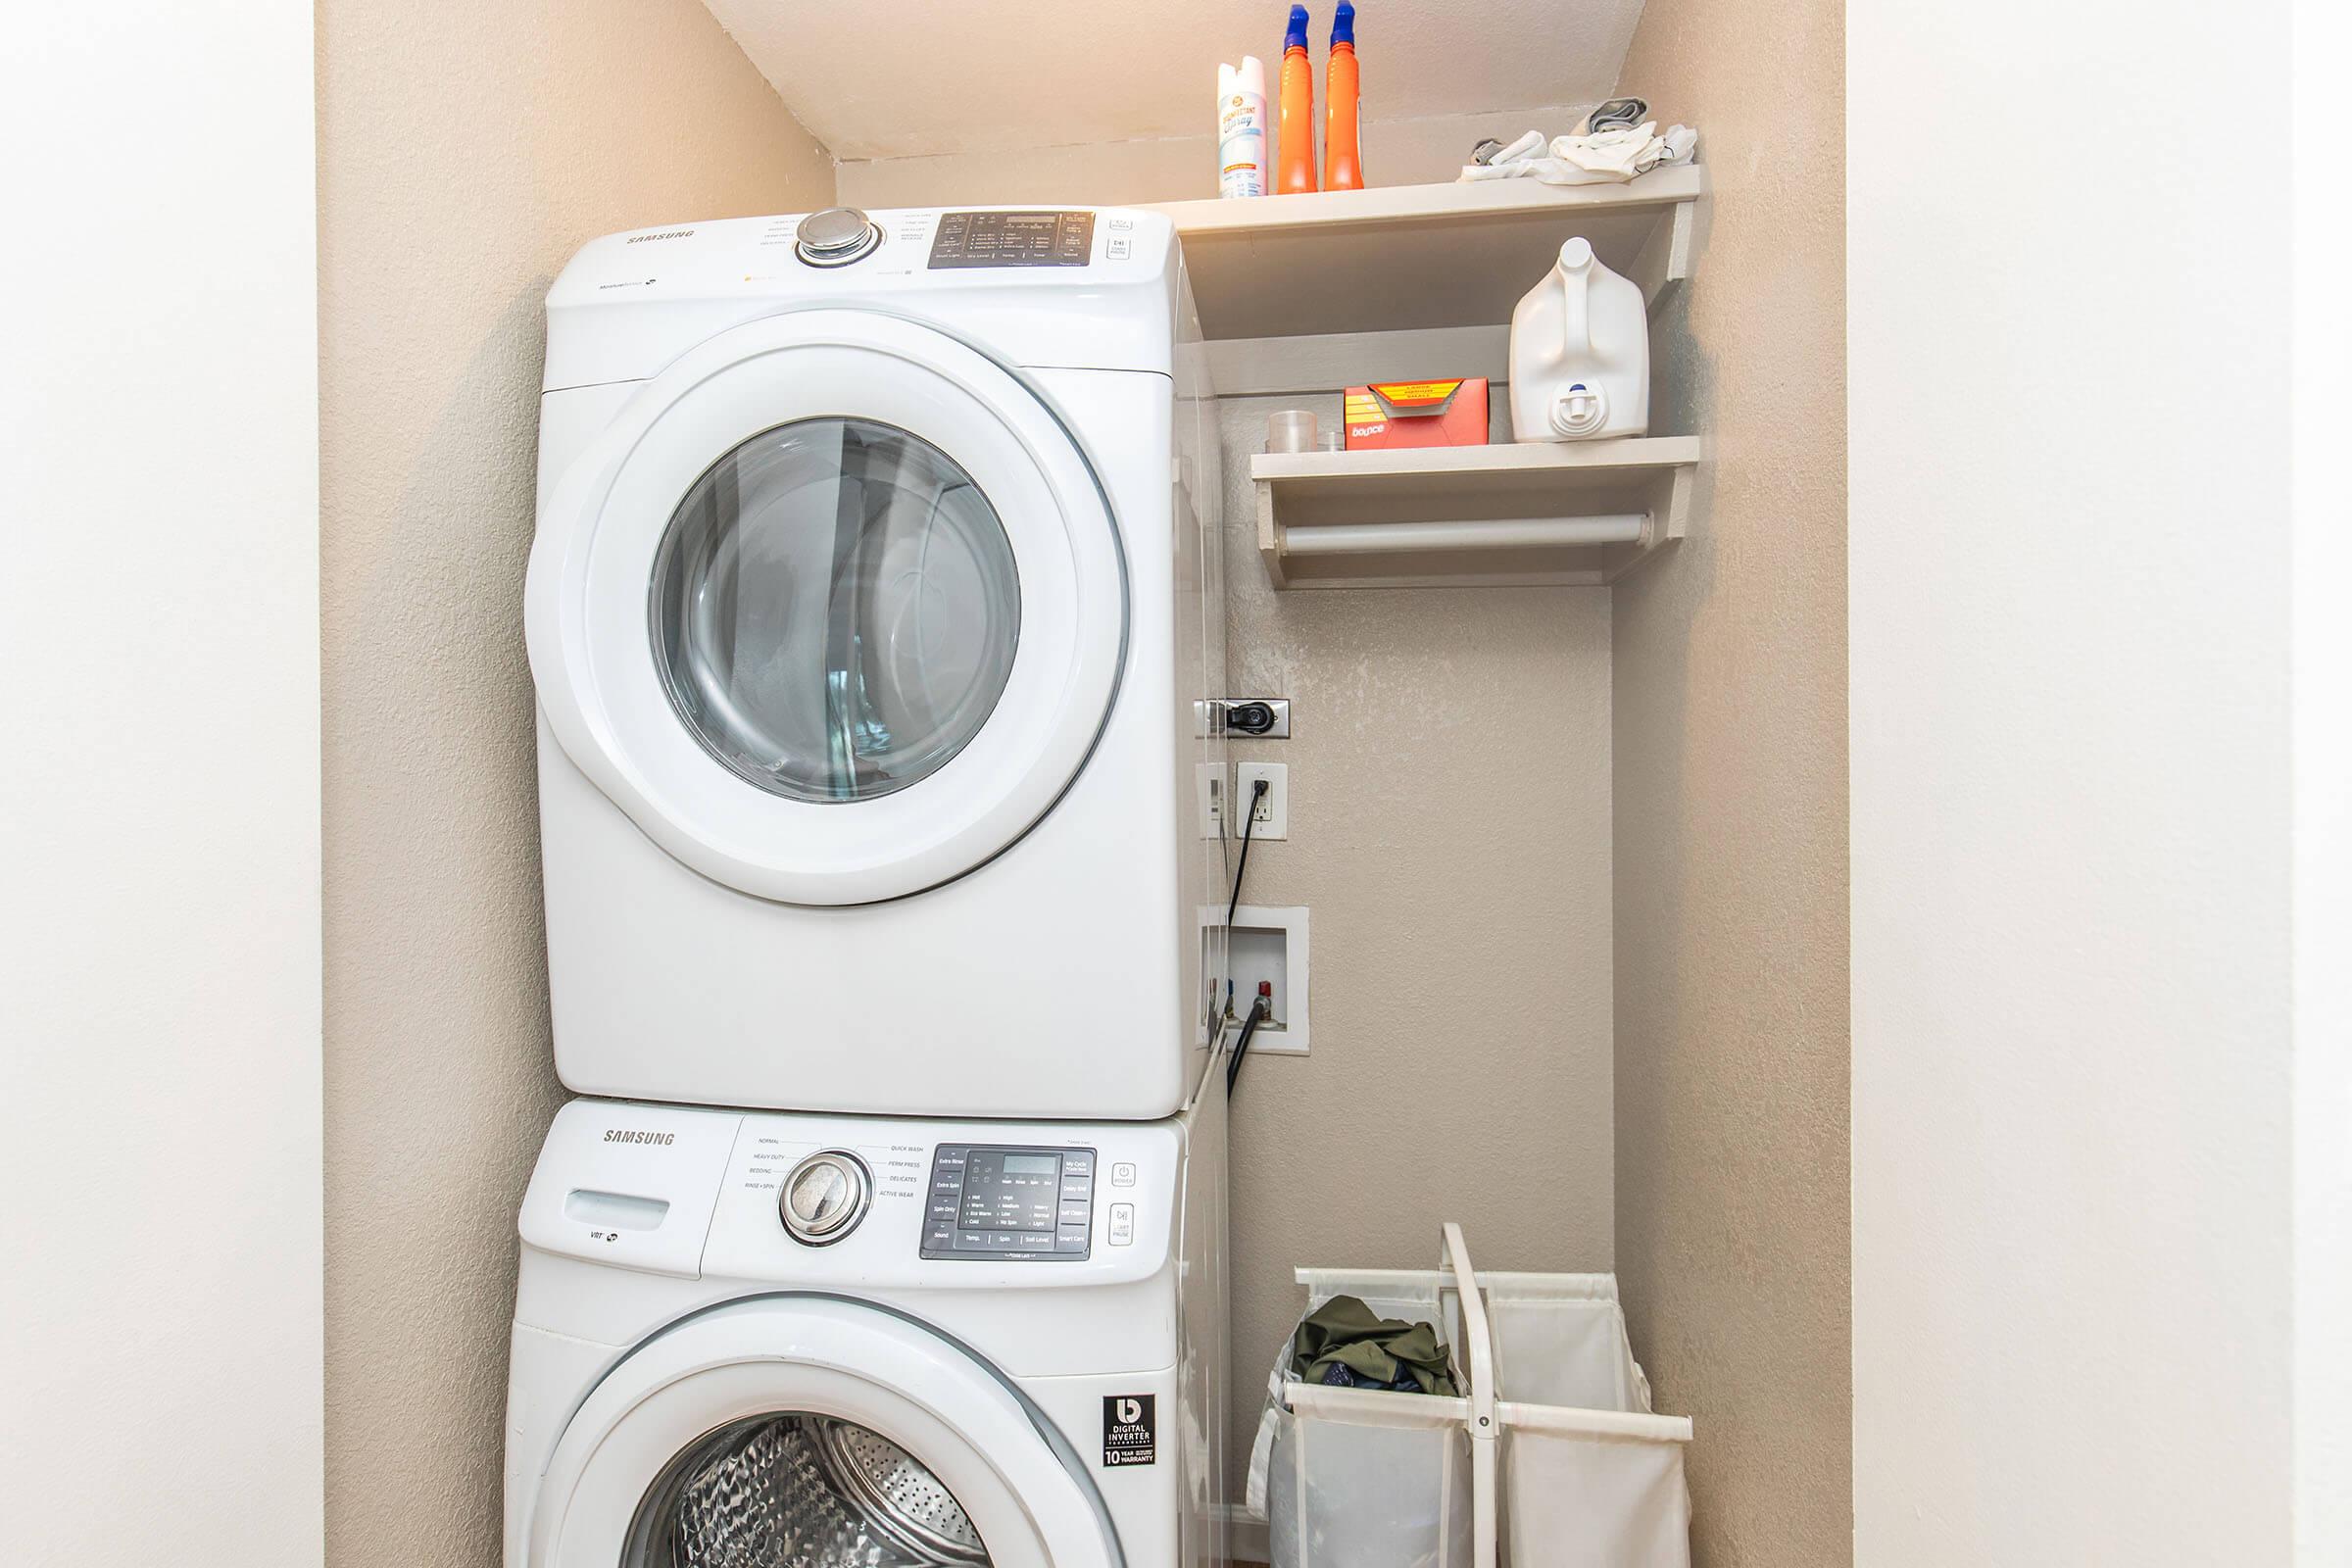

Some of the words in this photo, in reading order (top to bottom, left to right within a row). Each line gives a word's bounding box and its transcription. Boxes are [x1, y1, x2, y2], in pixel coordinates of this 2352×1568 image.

[627, 230, 695, 244] SAMSUNG
[1352, 424, 1385, 437] bounce
[604, 1129, 675, 1146] SAMSUNG
[1108, 1432, 1150, 1441] INVERTER
[1105, 1450, 1120, 1464] 10
